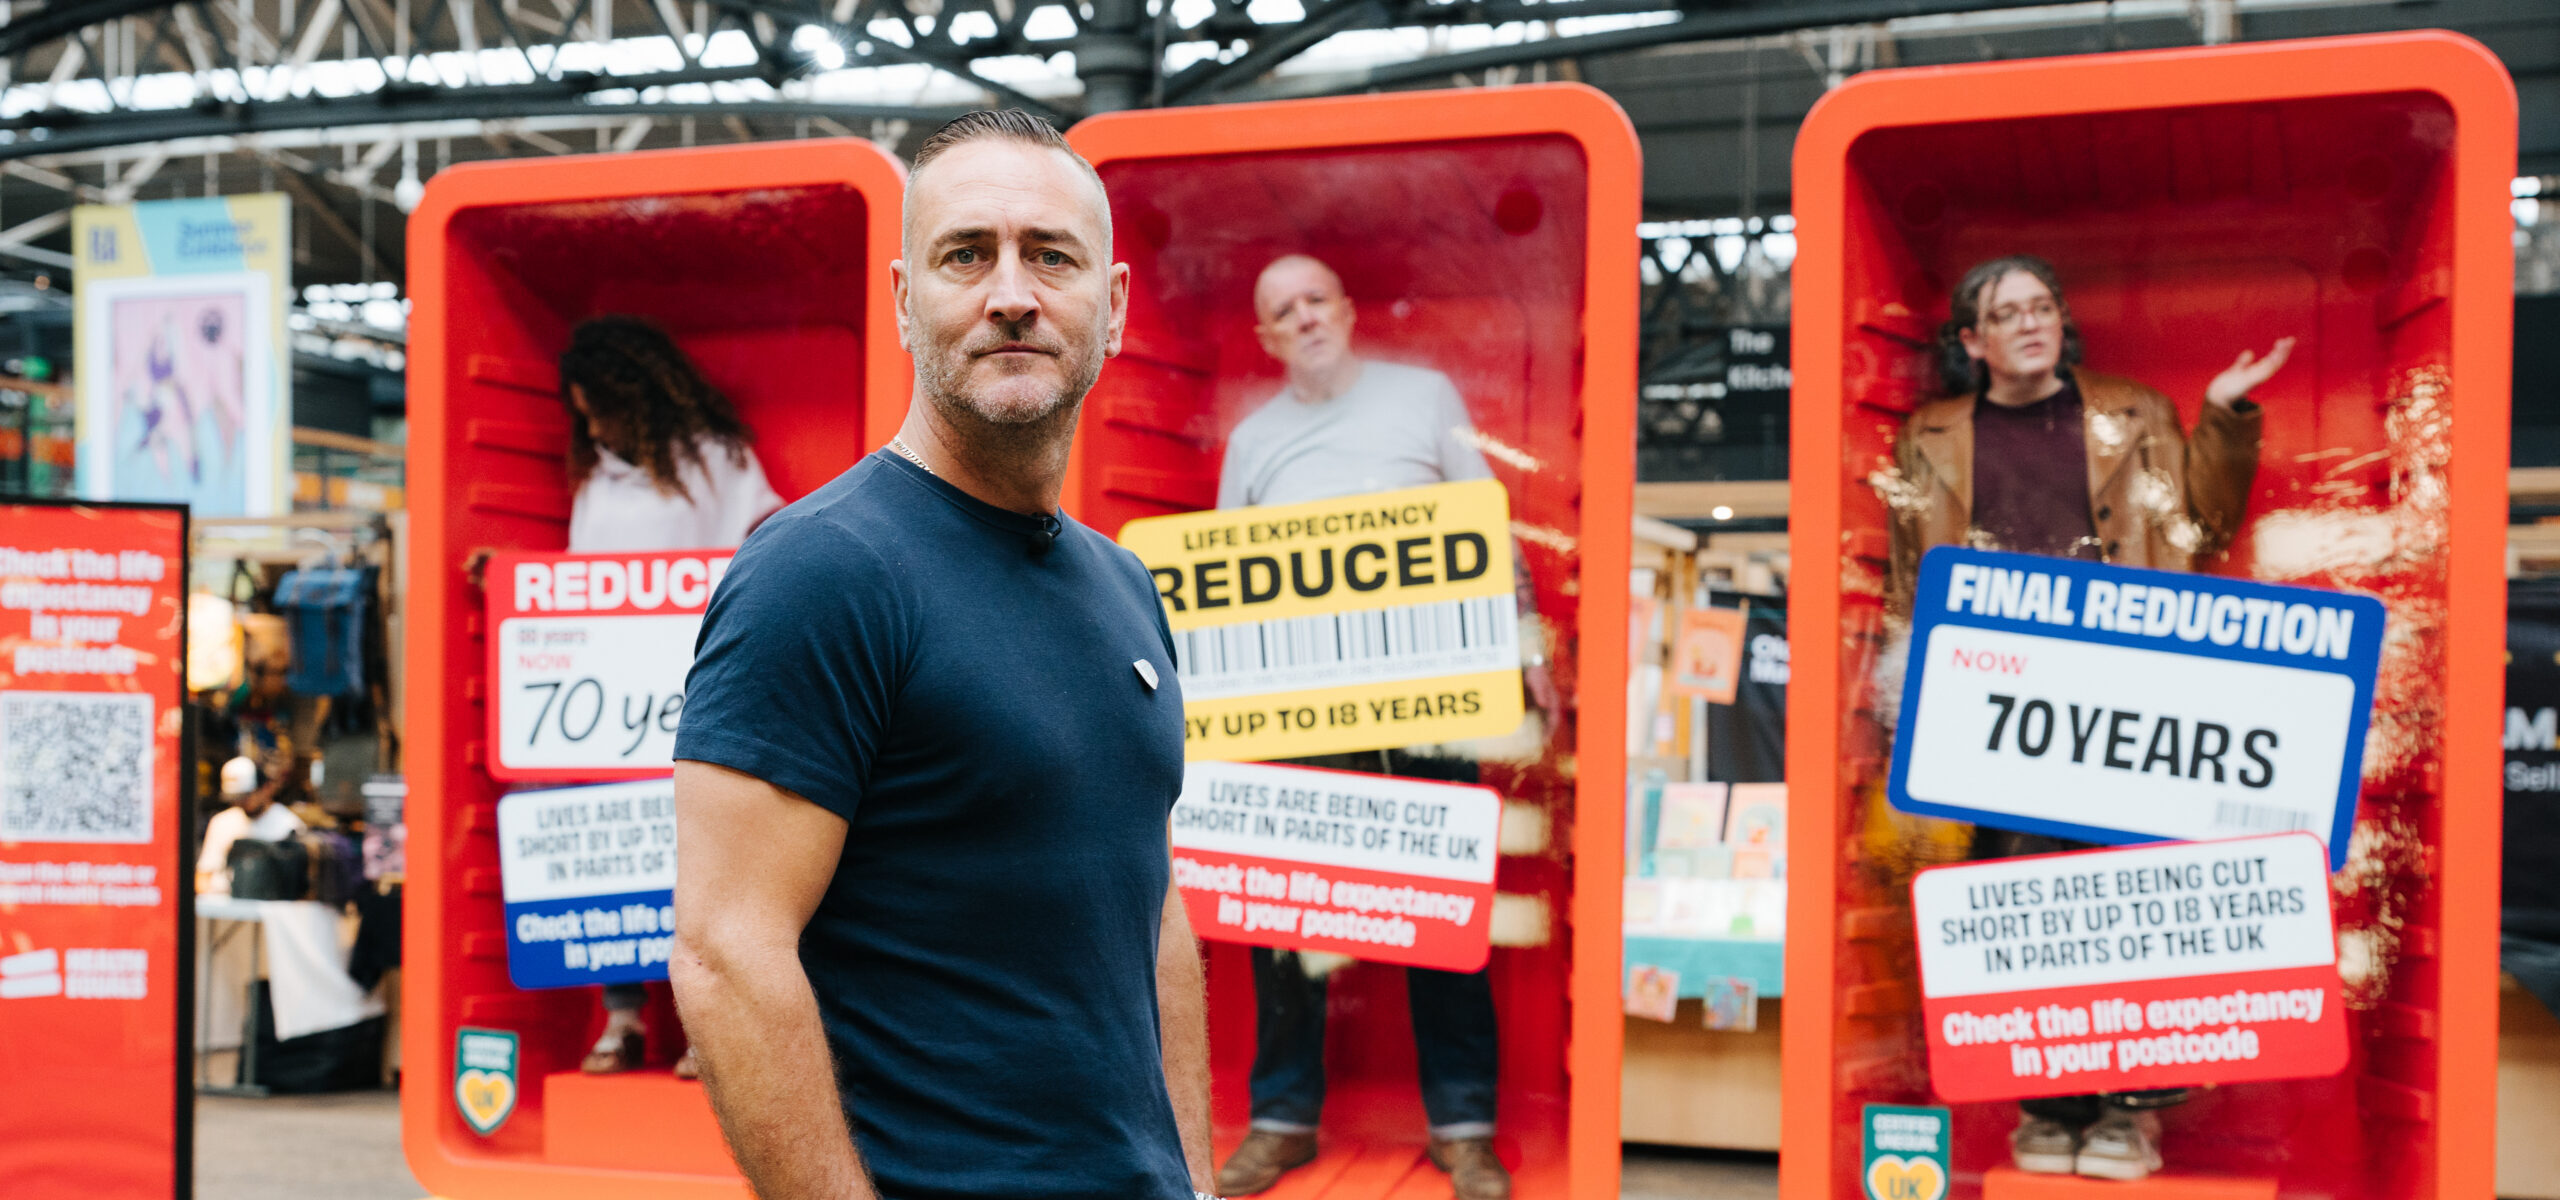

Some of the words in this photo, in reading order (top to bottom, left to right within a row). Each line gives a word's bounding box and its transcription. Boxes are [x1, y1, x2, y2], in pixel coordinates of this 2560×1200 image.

[1730, 329, 1775, 354] The
[1184, 525, 1240, 551] LIFE
[1249, 503, 1438, 544] EXPECTANCY
[0, 547, 70, 580] heck
[72, 549, 117, 581] the
[118, 550, 165, 582] life
[1150, 531, 1489, 612] REDUCED
[0, 582, 153, 617] expectancy
[1945, 563, 2075, 626] FINAL
[2081, 578, 2355, 661] REDUCTION
[31, 608, 59, 641] in
[60, 615, 122, 652] your
[543, 627, 588, 648] years
[14, 643, 138, 677] postcode
[518, 653, 571, 671] NOW
[1952, 648, 2029, 676] NOW
[524, 677, 604, 747] 70
[1223, 712, 1266, 736] UP
[1277, 707, 1316, 731] TO
[1329, 703, 1358, 726] 18
[1369, 691, 1481, 723] YEARS
[536, 804, 589, 829] LIVES
[596, 801, 632, 823] ARE
[1209, 778, 1269, 807] LIVES
[1277, 788, 1319, 815] ARE
[1327, 793, 1396, 823] BEING
[1404, 802, 1448, 829] CUT
[518, 832, 580, 858] SHORT
[588, 830, 610, 851] BY
[618, 827, 643, 848] UP
[650, 824, 674, 845] TO
[1175, 805, 1248, 834] SHORT
[1254, 814, 1275, 836] IN
[1283, 818, 1355, 848] PARTS
[1362, 827, 1389, 850] OF
[1398, 830, 1439, 858] THE
[1447, 836, 1481, 862] UK
[35, 861, 65, 884] the
[548, 861, 568, 881] IN
[574, 855, 635, 878] PARTS
[641, 851, 665, 874] OF
[1968, 879, 2044, 910] LIVES
[2053, 873, 2103, 902] ARE
[2116, 864, 2202, 897] BEING
[2212, 857, 2268, 889] CUT
[1172, 856, 1244, 895] Check
[1245, 866, 1288, 901] the
[1289, 870, 1331, 905] life
[1331, 880, 1475, 927] expectancy
[516, 909, 584, 943] Check
[583, 908, 621, 938] the
[621, 903, 659, 934] life
[1217, 894, 1245, 925] in
[1243, 901, 1302, 932] your
[1301, 908, 1416, 948] postcode
[1942, 912, 2032, 945] SHORT
[2042, 908, 2075, 936] BY
[2085, 904, 2122, 933] UP
[2131, 901, 2165, 928] TO
[2174, 896, 2201, 924] 18
[2208, 887, 2305, 920] YEARS
[564, 940, 589, 970] in
[588, 938, 637, 971] your
[1984, 947, 2013, 973] IN
[2023, 939, 2111, 971] PARTS
[2119, 934, 2155, 960] OF
[2163, 928, 2216, 957] THE
[2225, 924, 2265, 952] UK
[1942, 1006, 2035, 1046] Check
[2037, 1003, 2089, 1040] the
[2091, 998, 2143, 1035] life
[2147, 988, 2324, 1031] expectancy
[2010, 1042, 2042, 1077] in
[2044, 1039, 2116, 1079] your
[2116, 1026, 2260, 1073] postcode
[1889, 1176, 1923, 1200] UK
